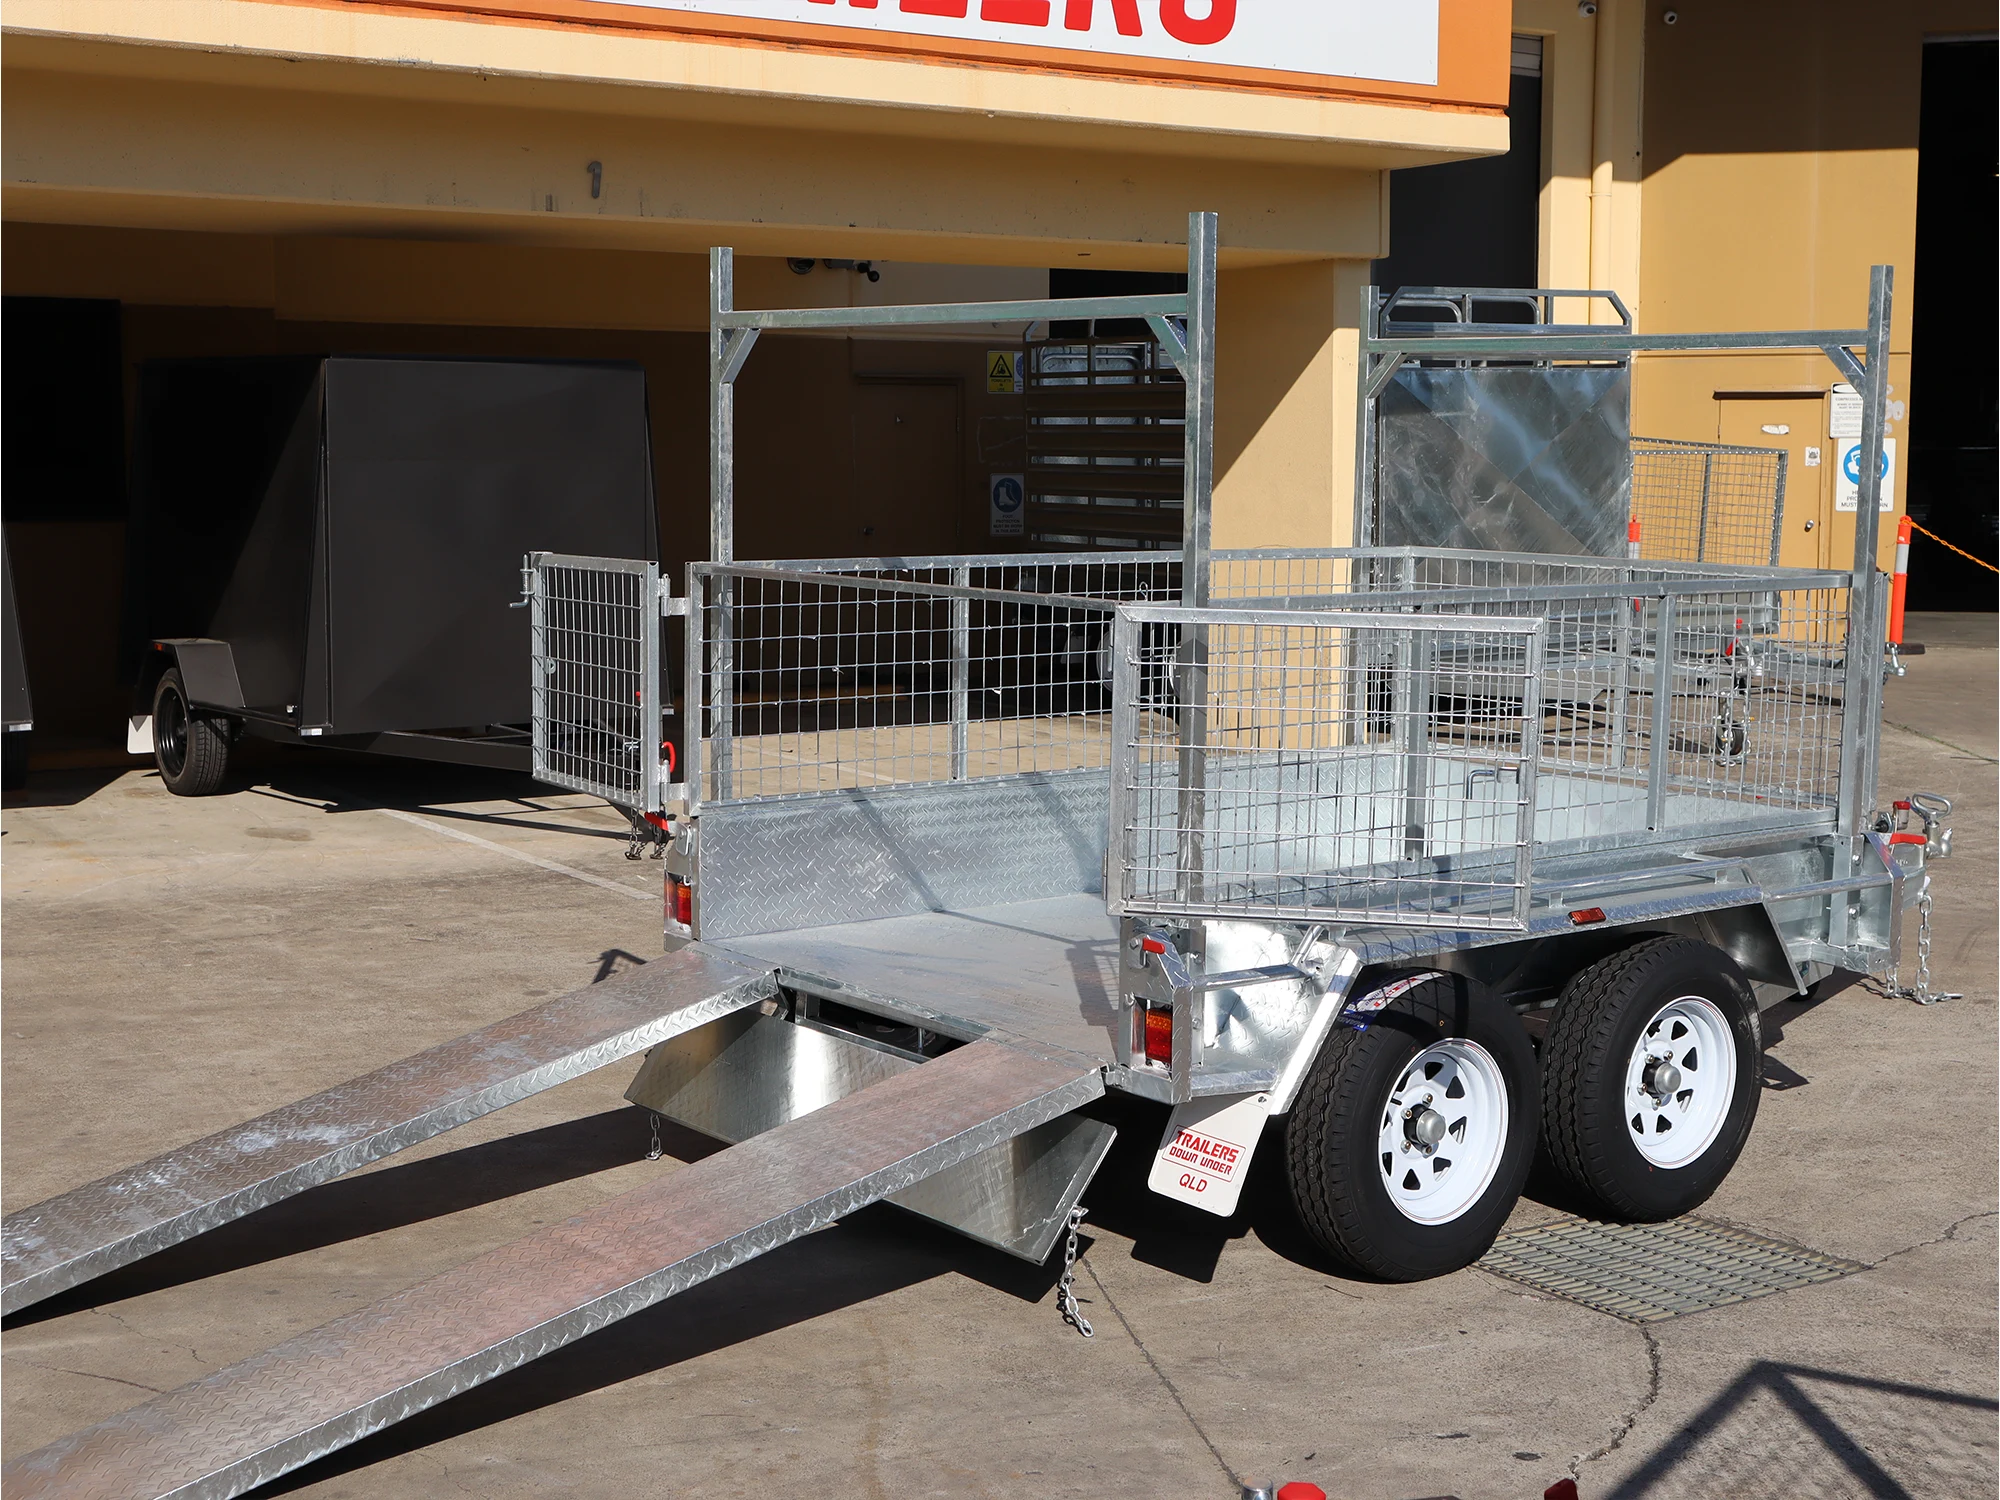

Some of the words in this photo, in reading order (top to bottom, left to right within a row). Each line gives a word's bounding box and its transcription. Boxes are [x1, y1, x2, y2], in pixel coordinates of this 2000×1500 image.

[586, 160, 603, 199] 1
[1169, 1146, 1199, 1163] DOWN
[1200, 1157, 1233, 1175] UNDER
[1175, 1130, 1239, 1163] TRAILERS
[1179, 1173, 1208, 1193] QLD
